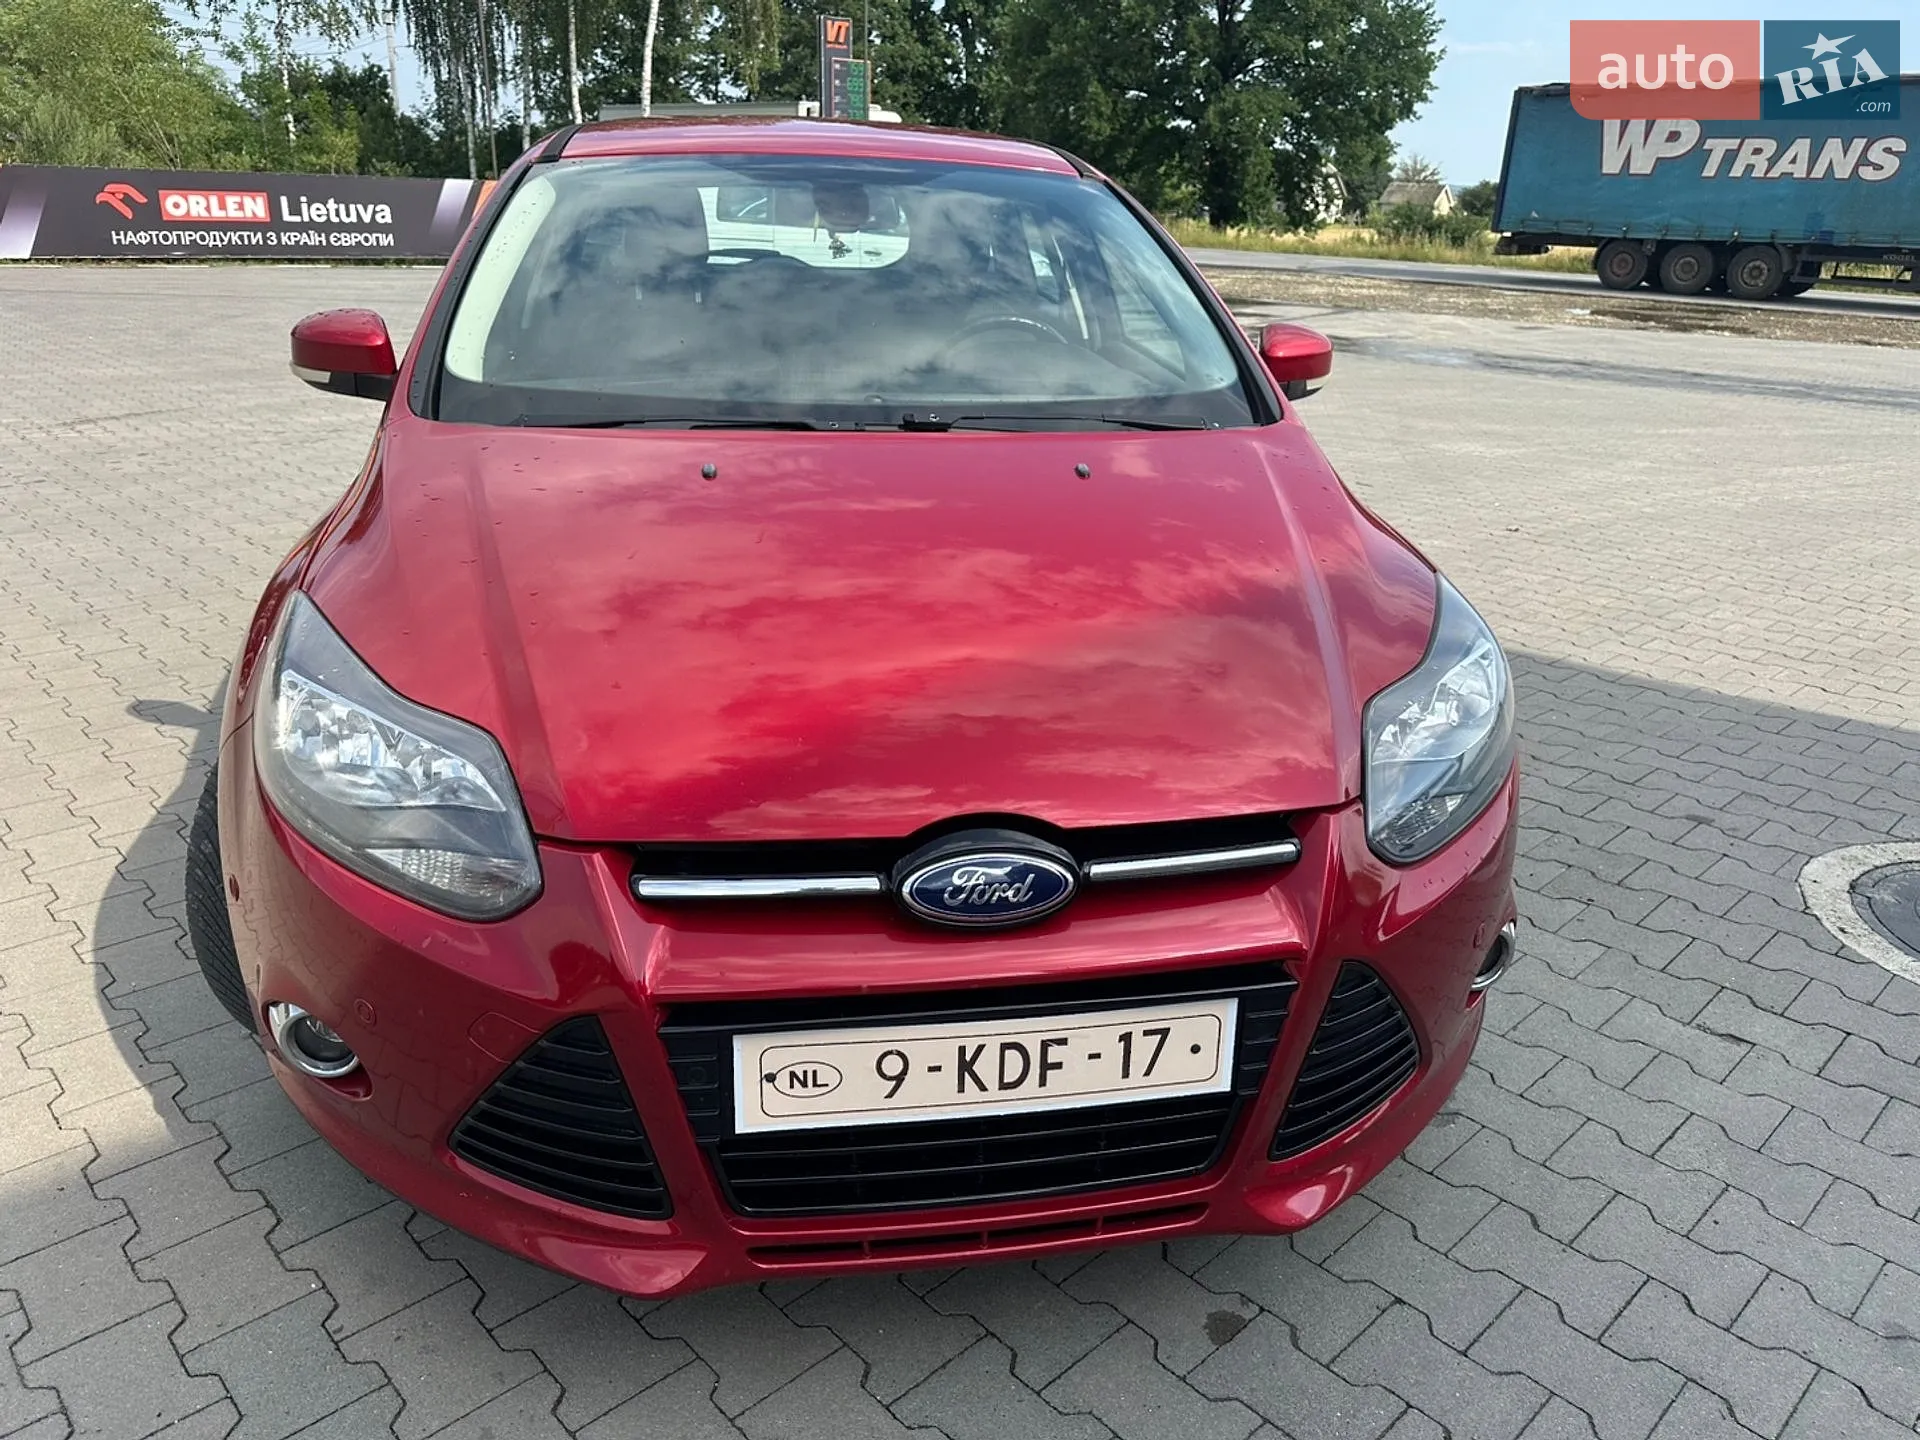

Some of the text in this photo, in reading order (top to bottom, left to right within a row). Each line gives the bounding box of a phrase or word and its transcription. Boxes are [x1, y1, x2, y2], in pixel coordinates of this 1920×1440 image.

[1602, 118, 1906, 181] WP TRANS
[165, 194, 393, 223] ORLEN Lietuva
[111, 230, 263, 247] НАФТОПРОДУКТИ
[280, 230, 326, 246] КРАЇН
[329, 232, 395, 247] ЄВРОПИ
[943, 865, 1034, 906] Ford
[788, 1068, 830, 1090] NL
